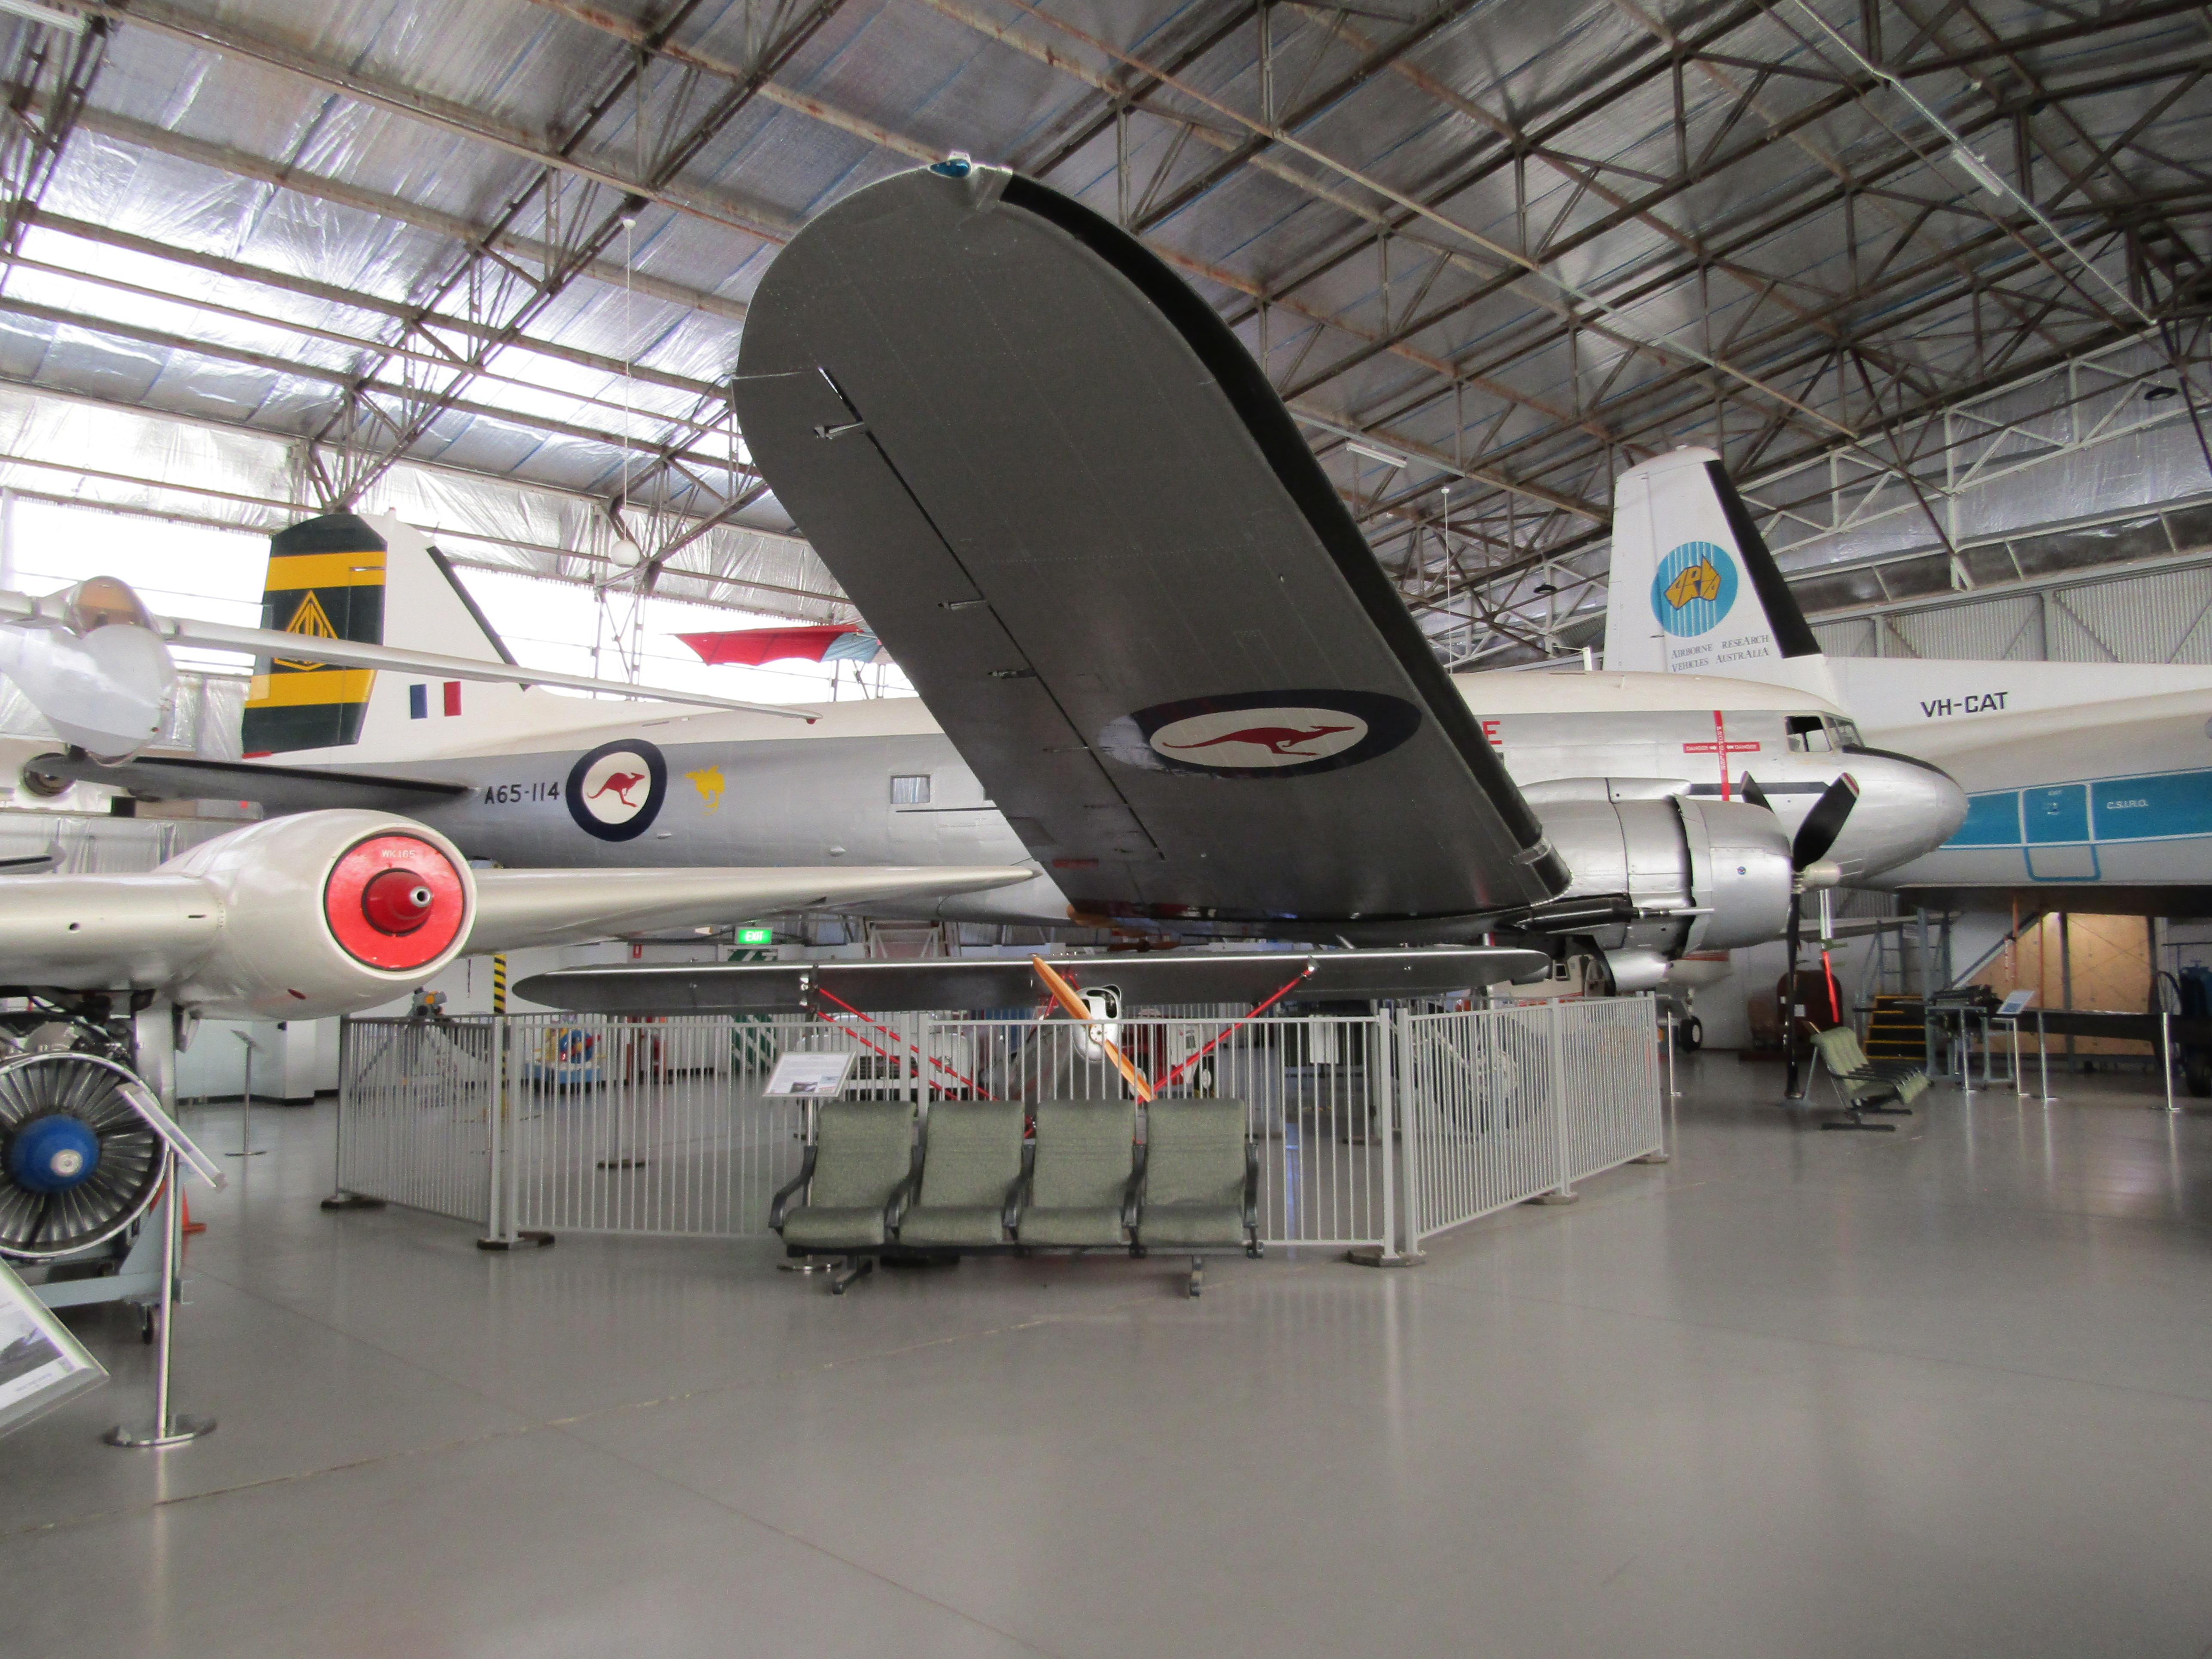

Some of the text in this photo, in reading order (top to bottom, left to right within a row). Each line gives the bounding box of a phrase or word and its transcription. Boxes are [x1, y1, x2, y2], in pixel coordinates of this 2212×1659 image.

[1671, 635, 1769, 659] AIRBORNE RESEARCH
[1671, 647, 1769, 672] VEHICLES AUSTRALIA
[1920, 691, 2008, 717] VH-CAT
[1716, 726, 1726, 770] PROPELLER
[485, 781, 560, 804] A65-114
[746, 931, 763, 942] EXIT
